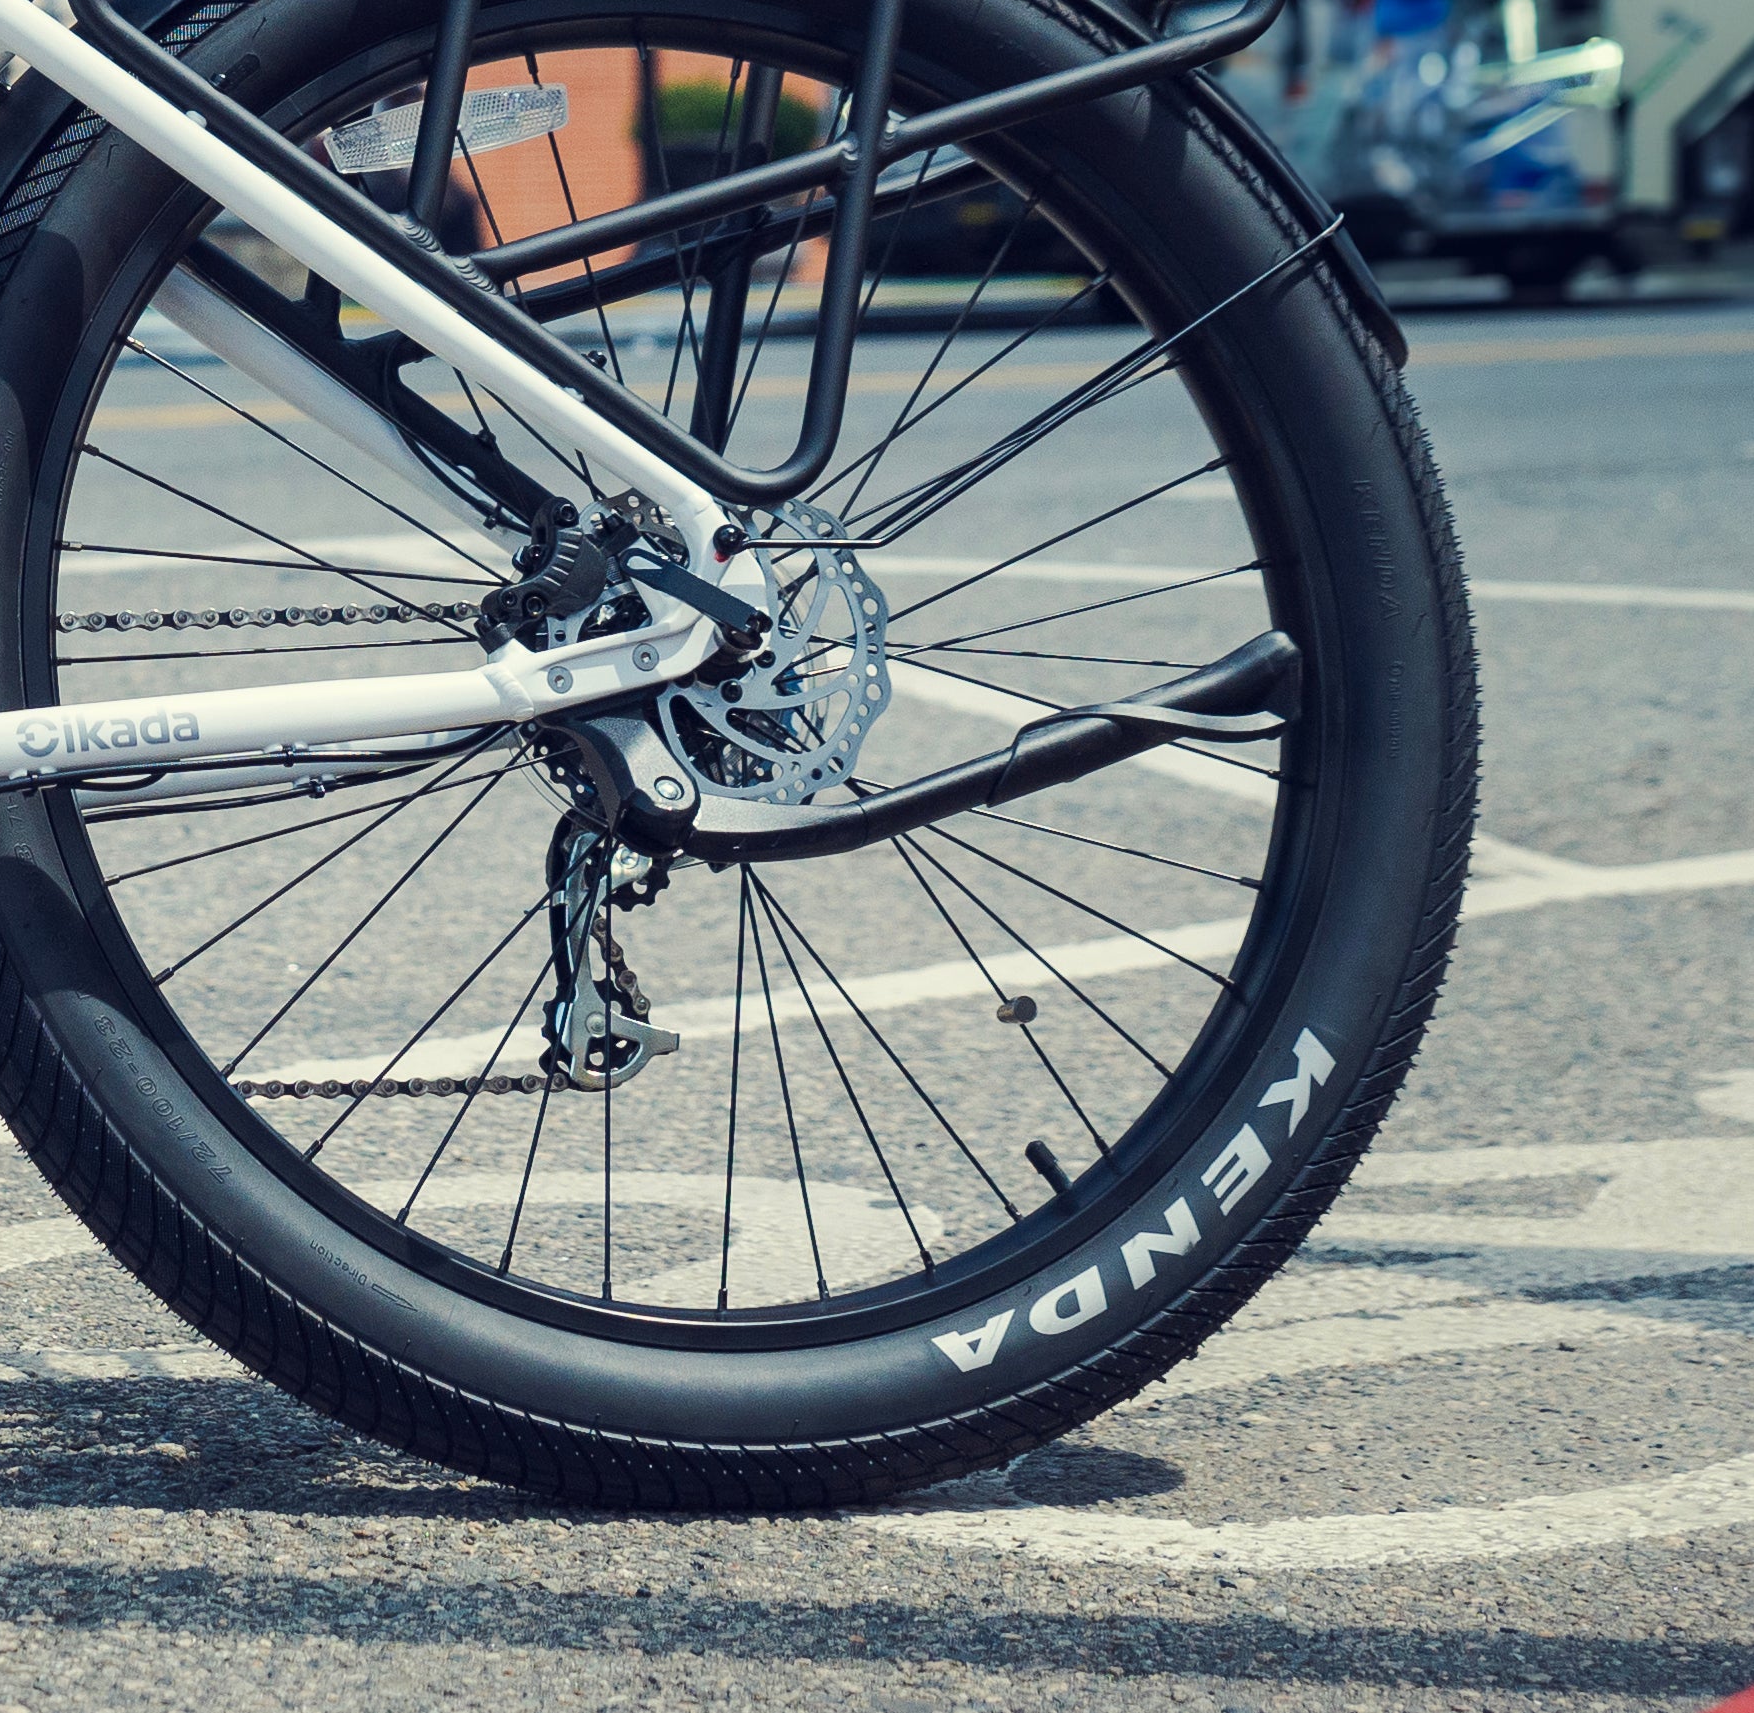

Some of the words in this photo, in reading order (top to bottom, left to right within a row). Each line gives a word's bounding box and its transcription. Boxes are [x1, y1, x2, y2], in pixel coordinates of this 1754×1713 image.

[16, 706, 200, 758] Cikada
[930, 1027, 1336, 1373] KENDA
[308, 1239, 368, 1287] Direction
